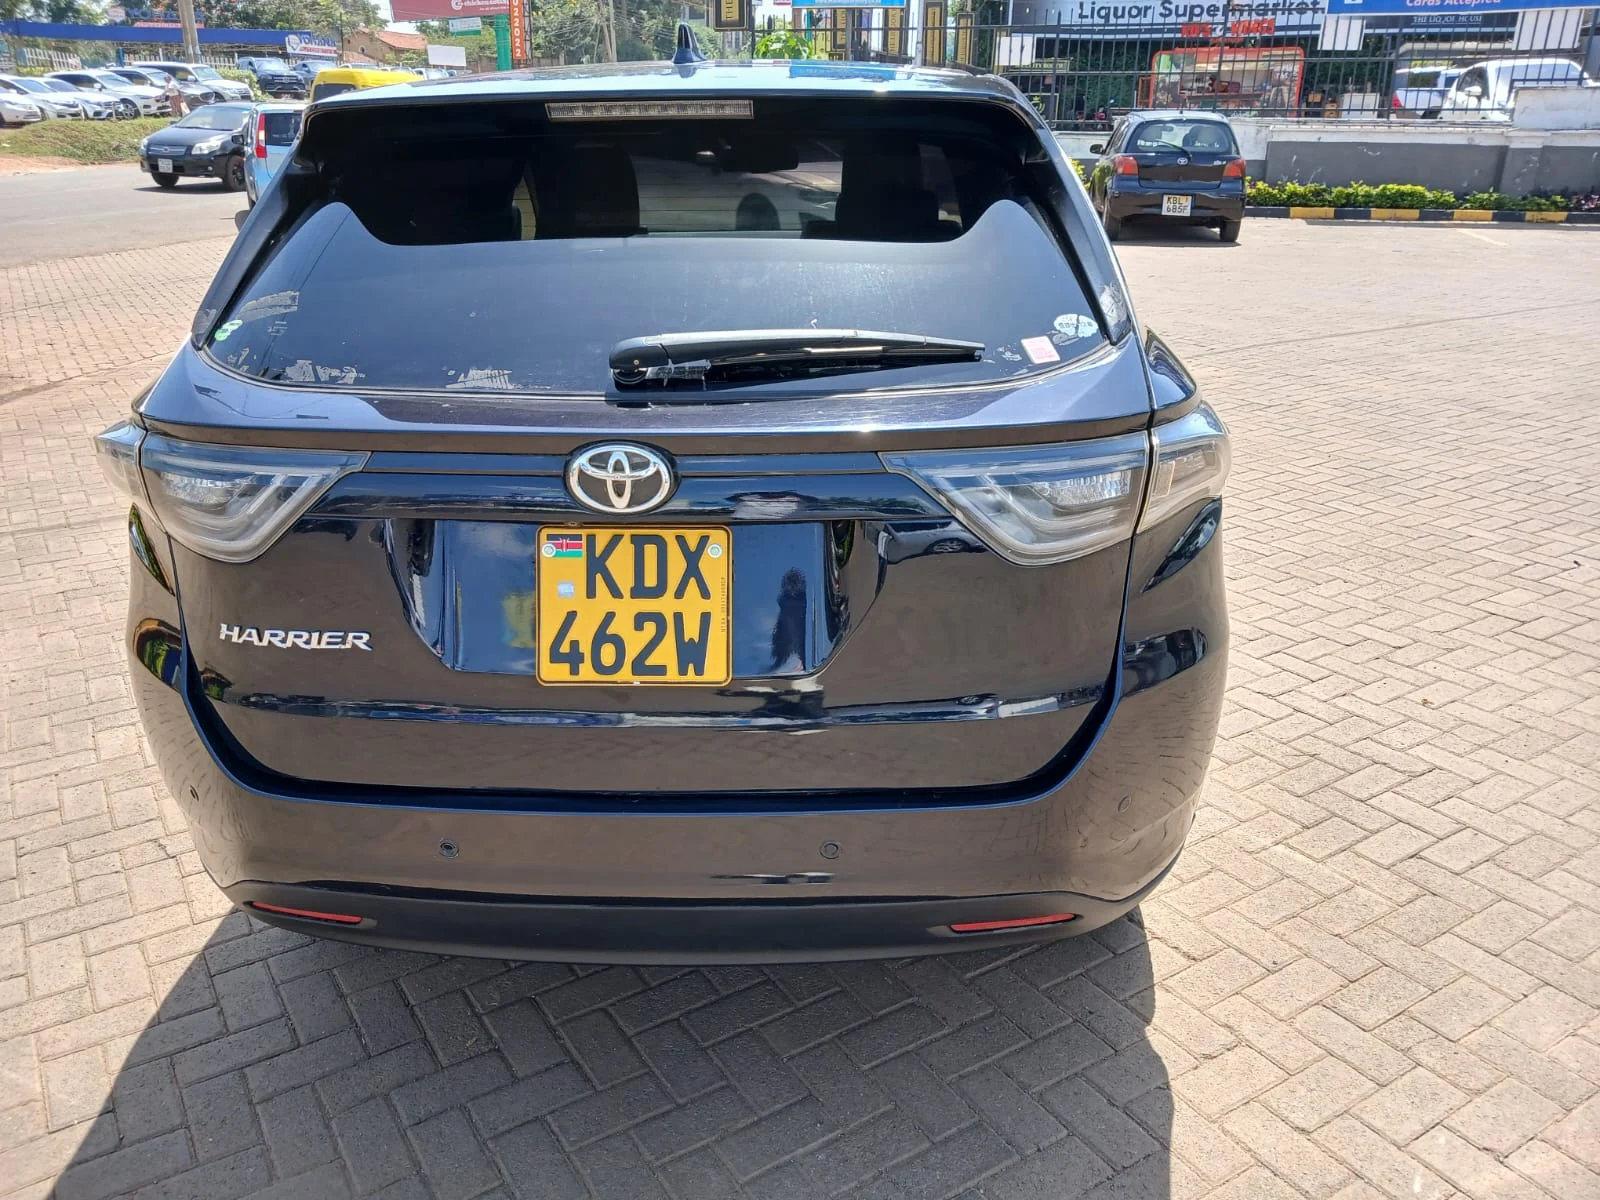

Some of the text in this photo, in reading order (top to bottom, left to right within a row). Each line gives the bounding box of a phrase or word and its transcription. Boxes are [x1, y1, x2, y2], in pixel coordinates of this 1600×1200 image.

[1078, 1, 1152, 24] Liquor
[1167, 205, 1188, 213] 685F
[586, 534, 711, 599] KDX
[220, 623, 373, 651] HARRIER
[550, 610, 711, 676] 462W
